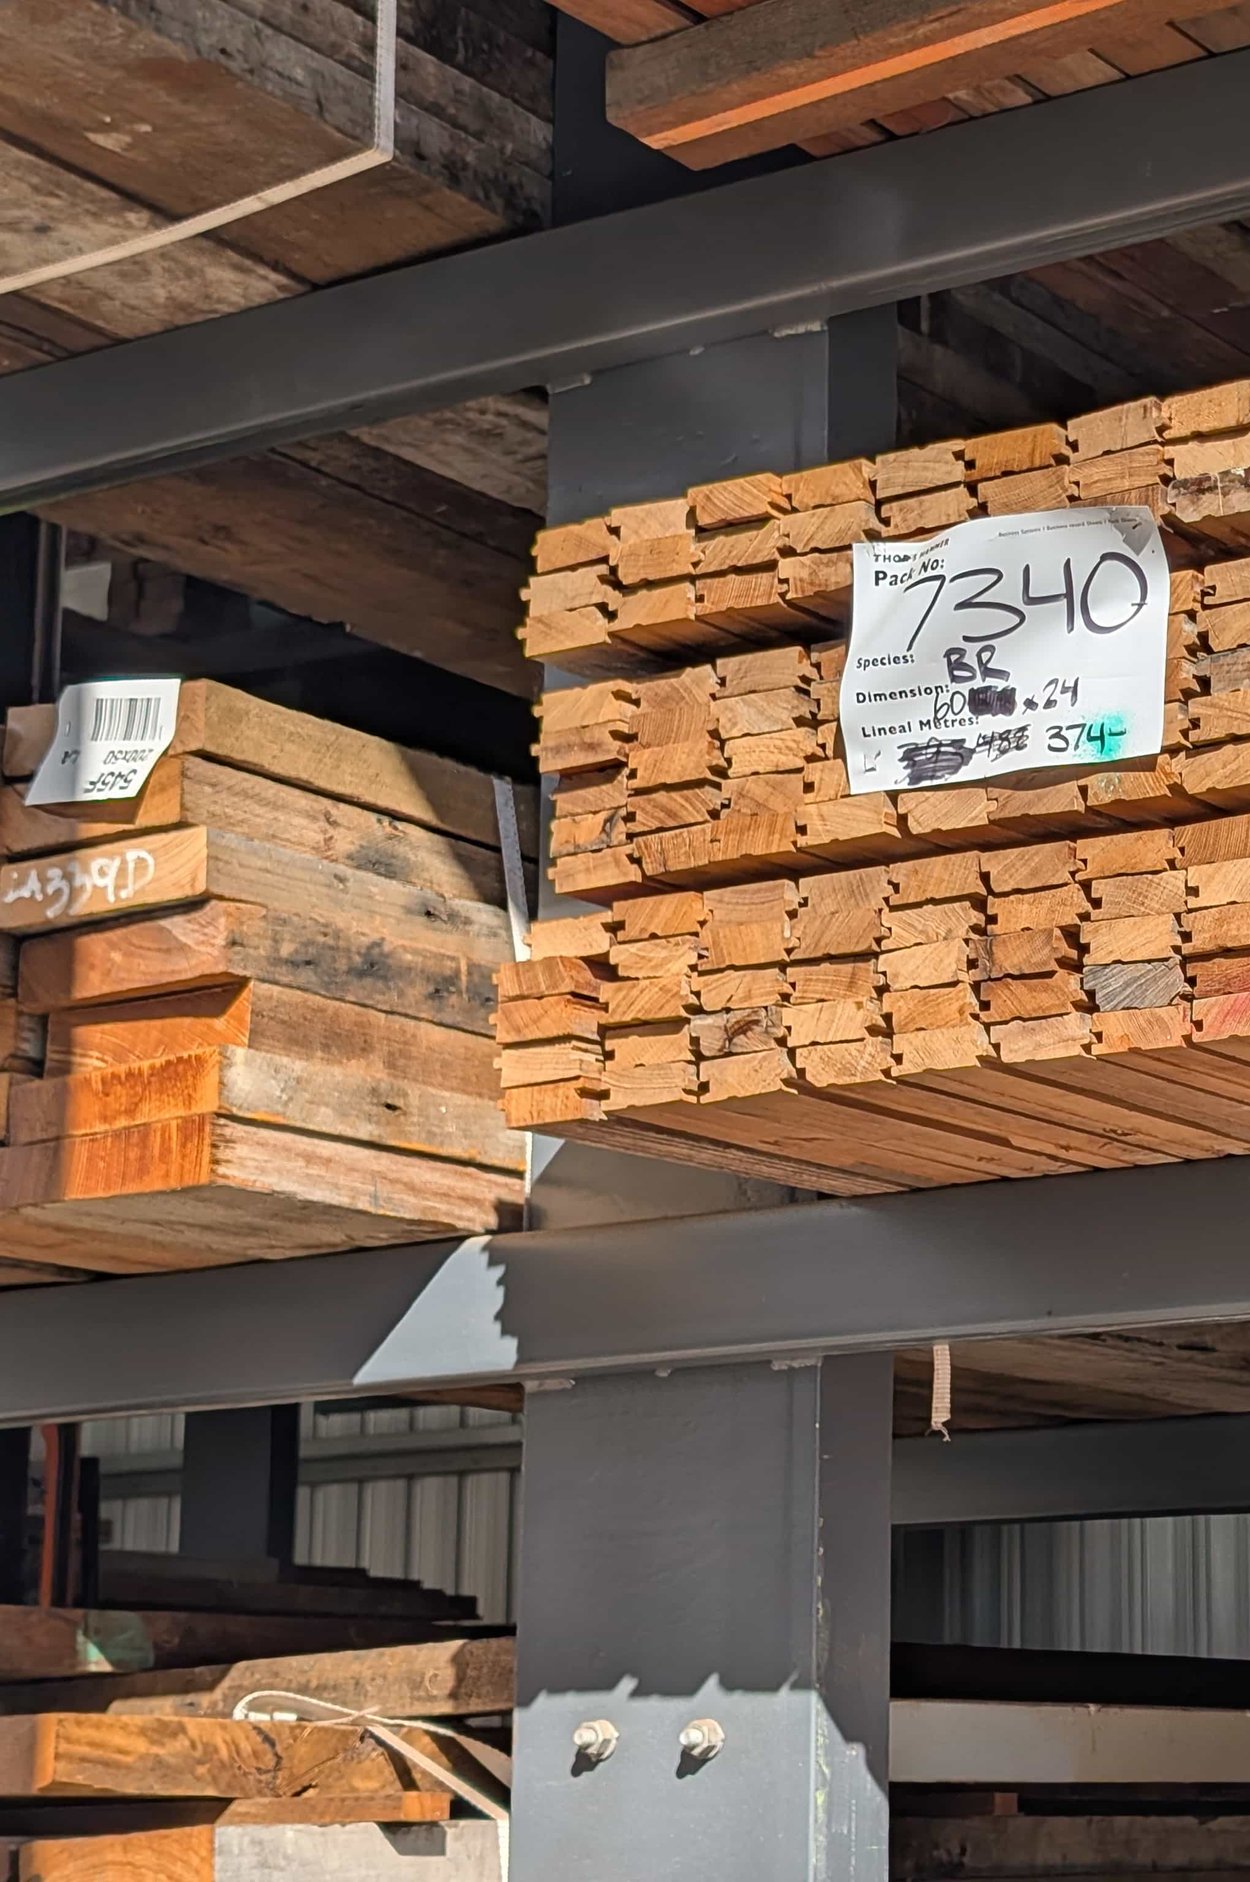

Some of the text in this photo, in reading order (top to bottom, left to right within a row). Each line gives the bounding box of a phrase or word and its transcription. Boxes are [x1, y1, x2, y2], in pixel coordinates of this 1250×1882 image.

[874, 567, 916, 587] Pack
[903, 552, 1148, 652] 7340
[856, 653, 915, 671] Species:
[943, 644, 1010, 684] BR
[856, 684, 951, 704] Dimension:
[934, 691, 967, 725] 60
[861, 716, 980, 738] Lineal Metres:
